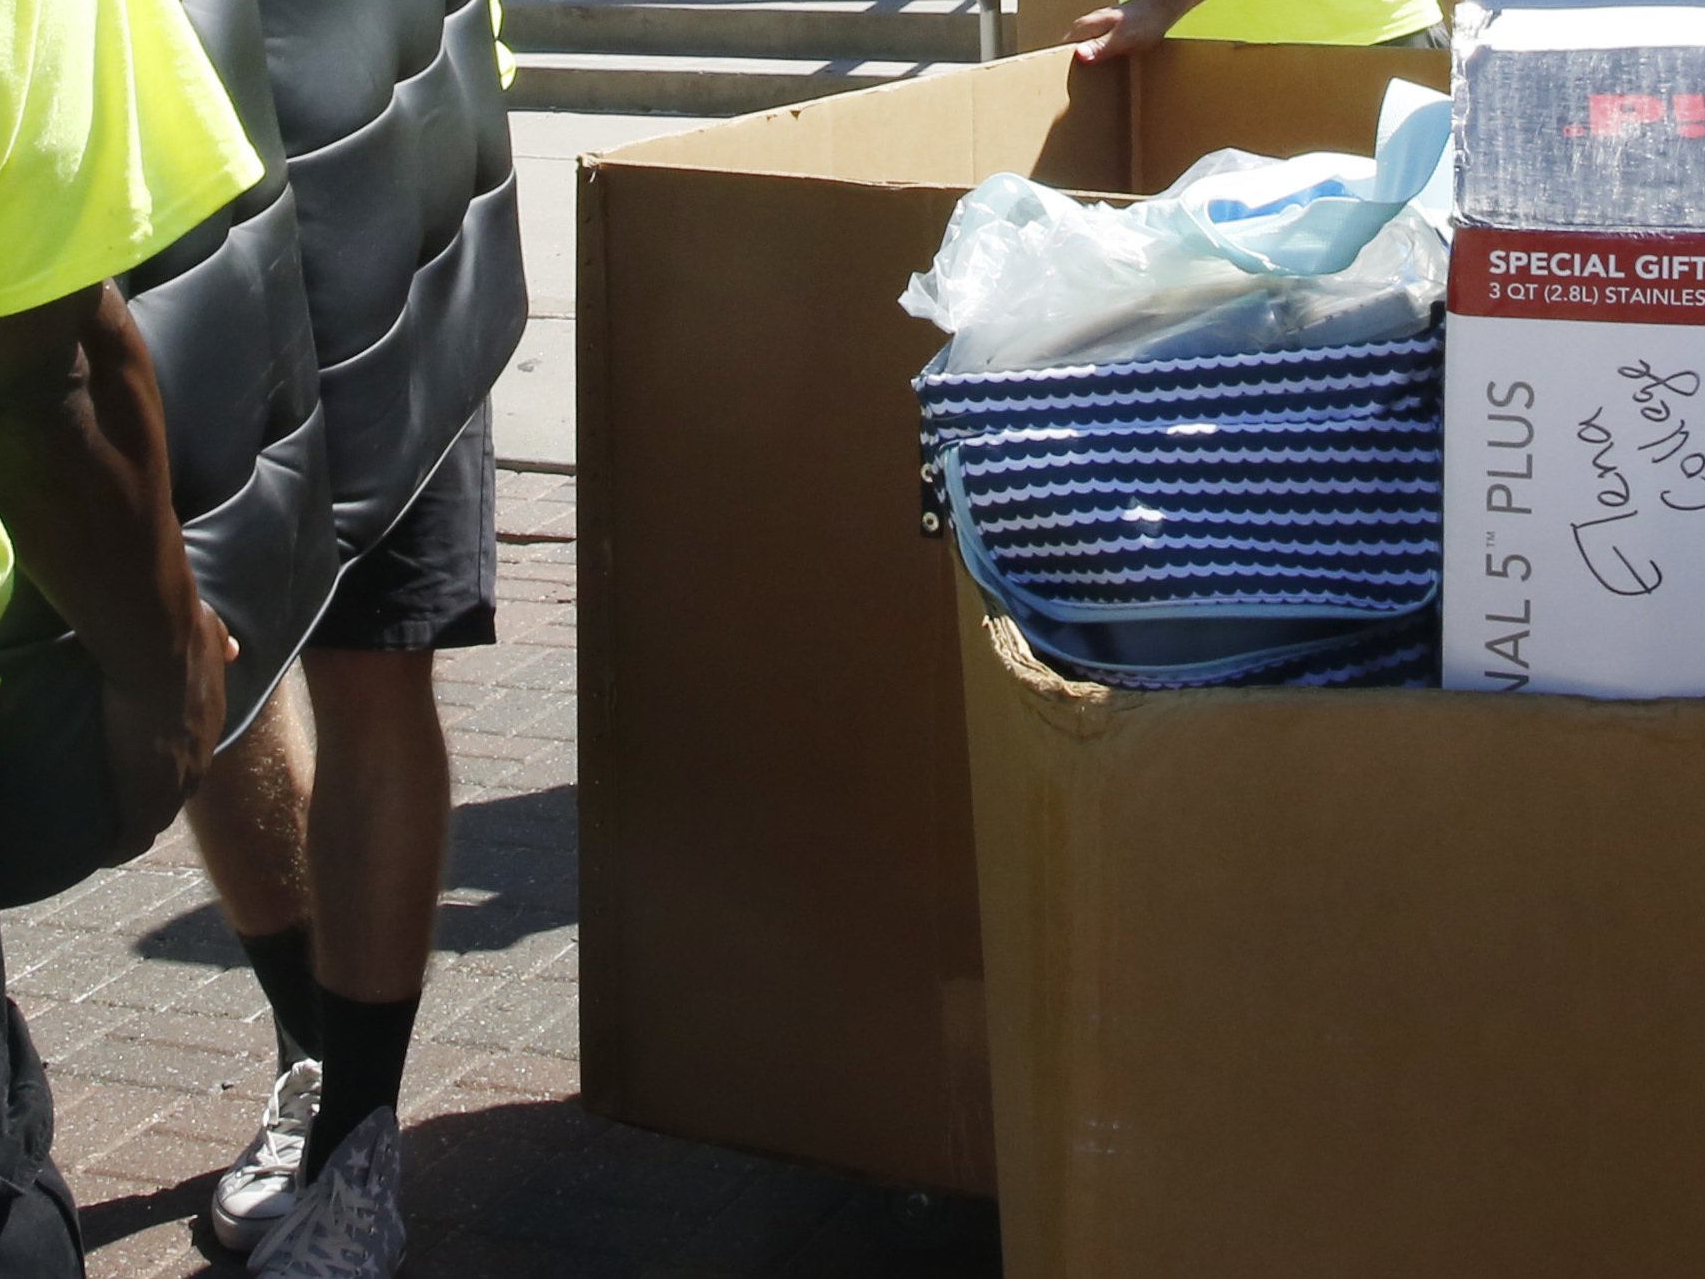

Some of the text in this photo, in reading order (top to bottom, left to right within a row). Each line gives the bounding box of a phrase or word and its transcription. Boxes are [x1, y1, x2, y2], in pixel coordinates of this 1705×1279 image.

[1488, 249, 1626, 279] SPECIAL
[1489, 282, 1501, 299] 3
[1506, 282, 1539, 301] QT
[1543, 283, 1599, 306] (2.8L)
[1486, 380, 1536, 515] PLUS
